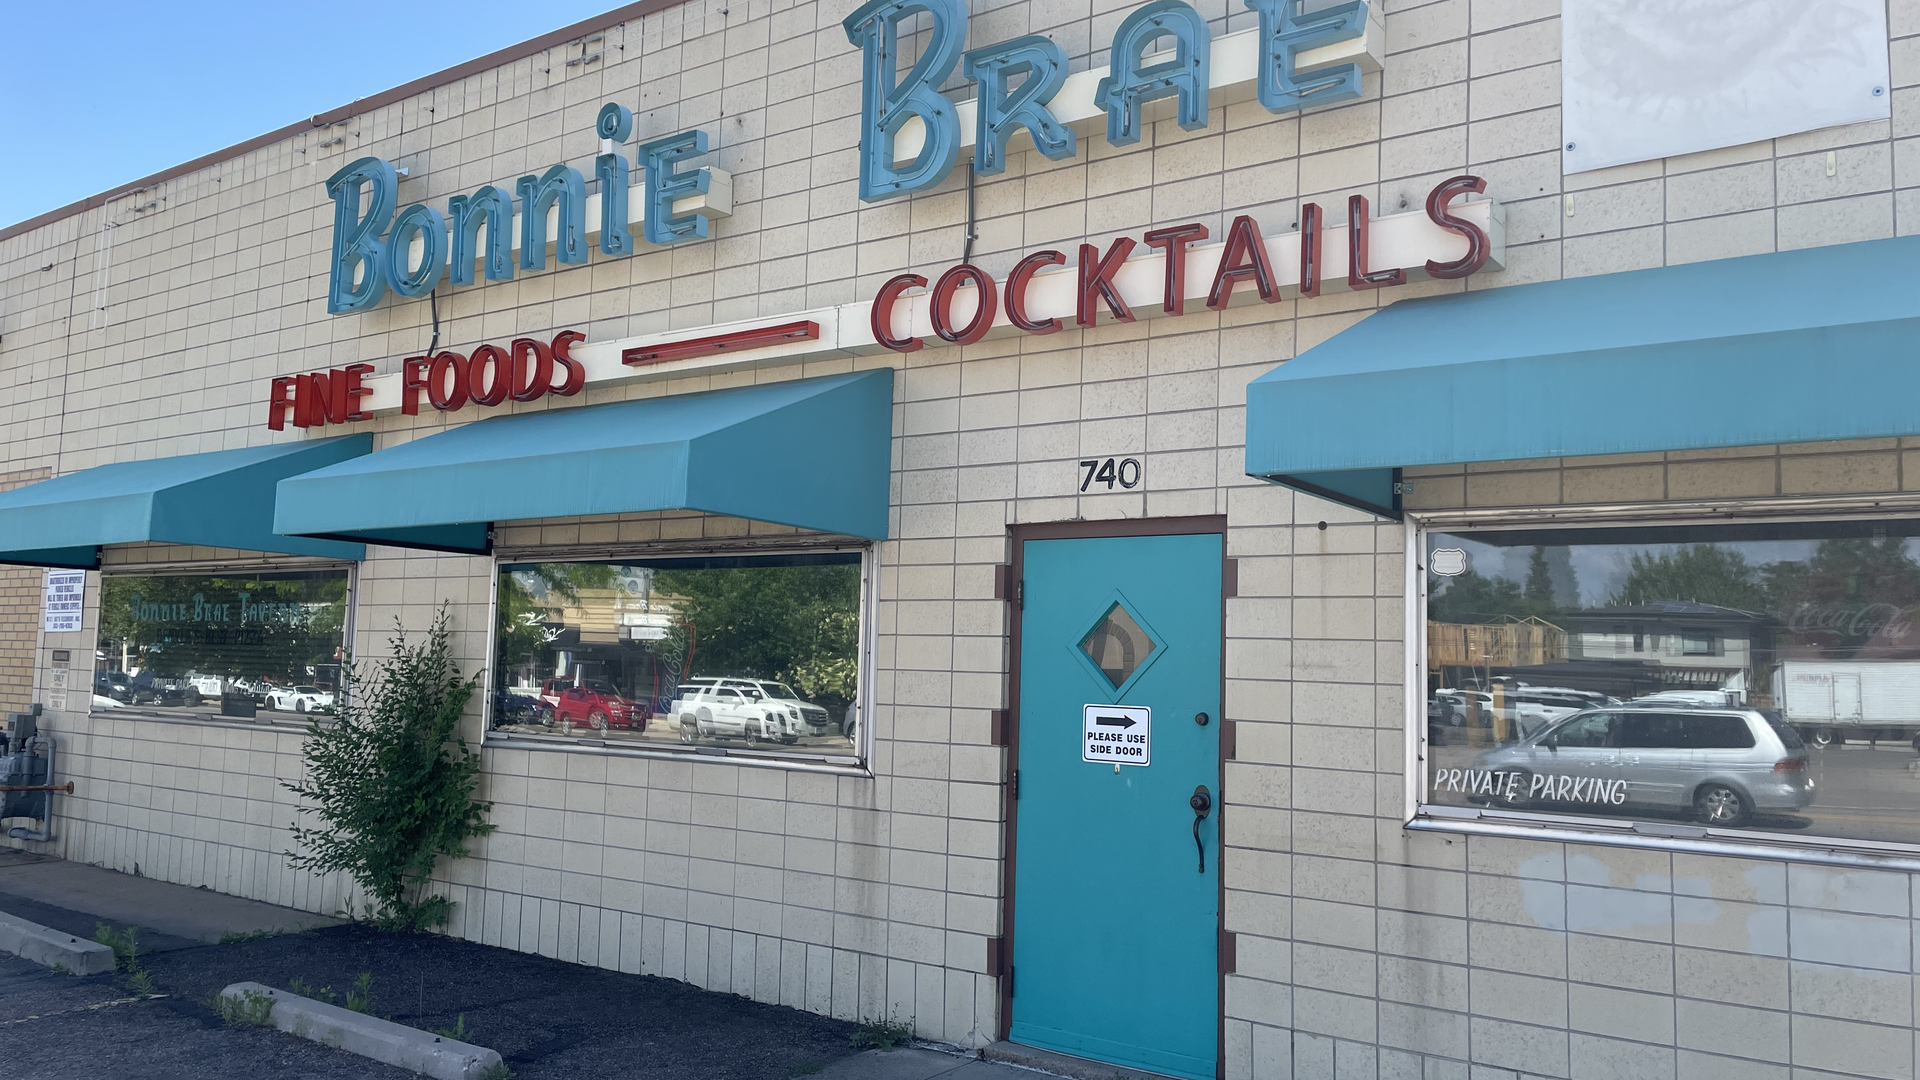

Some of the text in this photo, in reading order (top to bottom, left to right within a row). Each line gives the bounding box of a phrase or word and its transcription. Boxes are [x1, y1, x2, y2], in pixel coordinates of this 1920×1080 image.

[842, 0, 1367, 203] BRAE
[268, 175, 1490, 431] FINE FOODS COCKTAILS
[1080, 458, 1142, 492] 740
[1087, 731, 1146, 744] PLEASE USE
[1090, 744, 1142, 756] SIDE DOOR
[1434, 768, 1627, 805] PRIVATE PARKING
